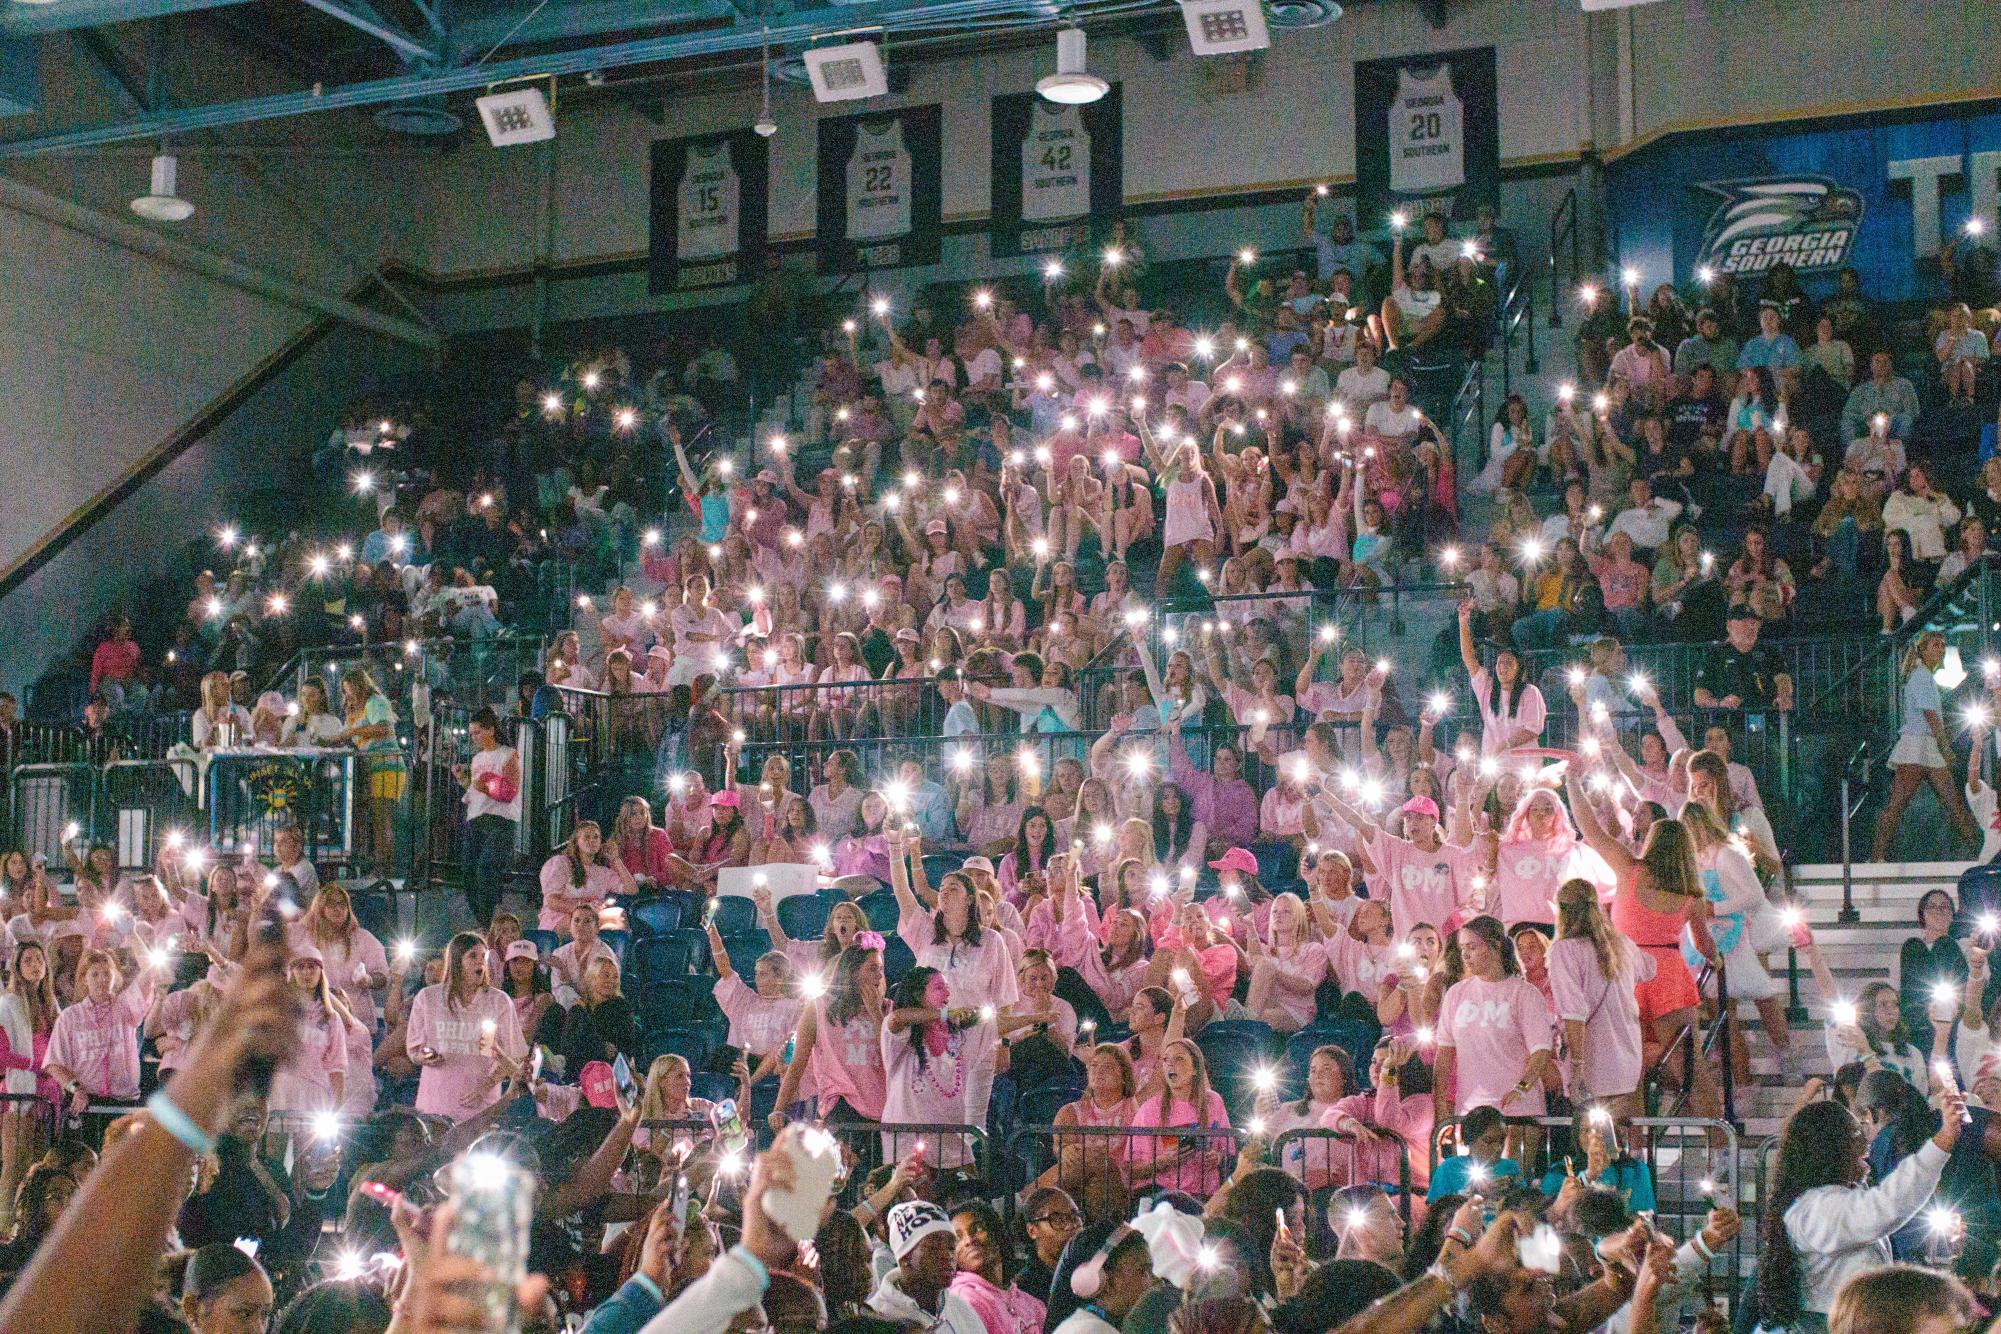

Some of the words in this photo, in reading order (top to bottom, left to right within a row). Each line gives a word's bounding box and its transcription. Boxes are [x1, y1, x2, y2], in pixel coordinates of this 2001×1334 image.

[1410, 113, 1441, 140] 20
[1040, 145, 1072, 172] 42
[1403, 144, 1450, 159] SOUTHERN
[866, 165, 892, 193] 22
[699, 186, 719, 213] 15
[1731, 230, 1848, 256] GEORGIA
[1721, 248, 1842, 274] SOUTHERN
